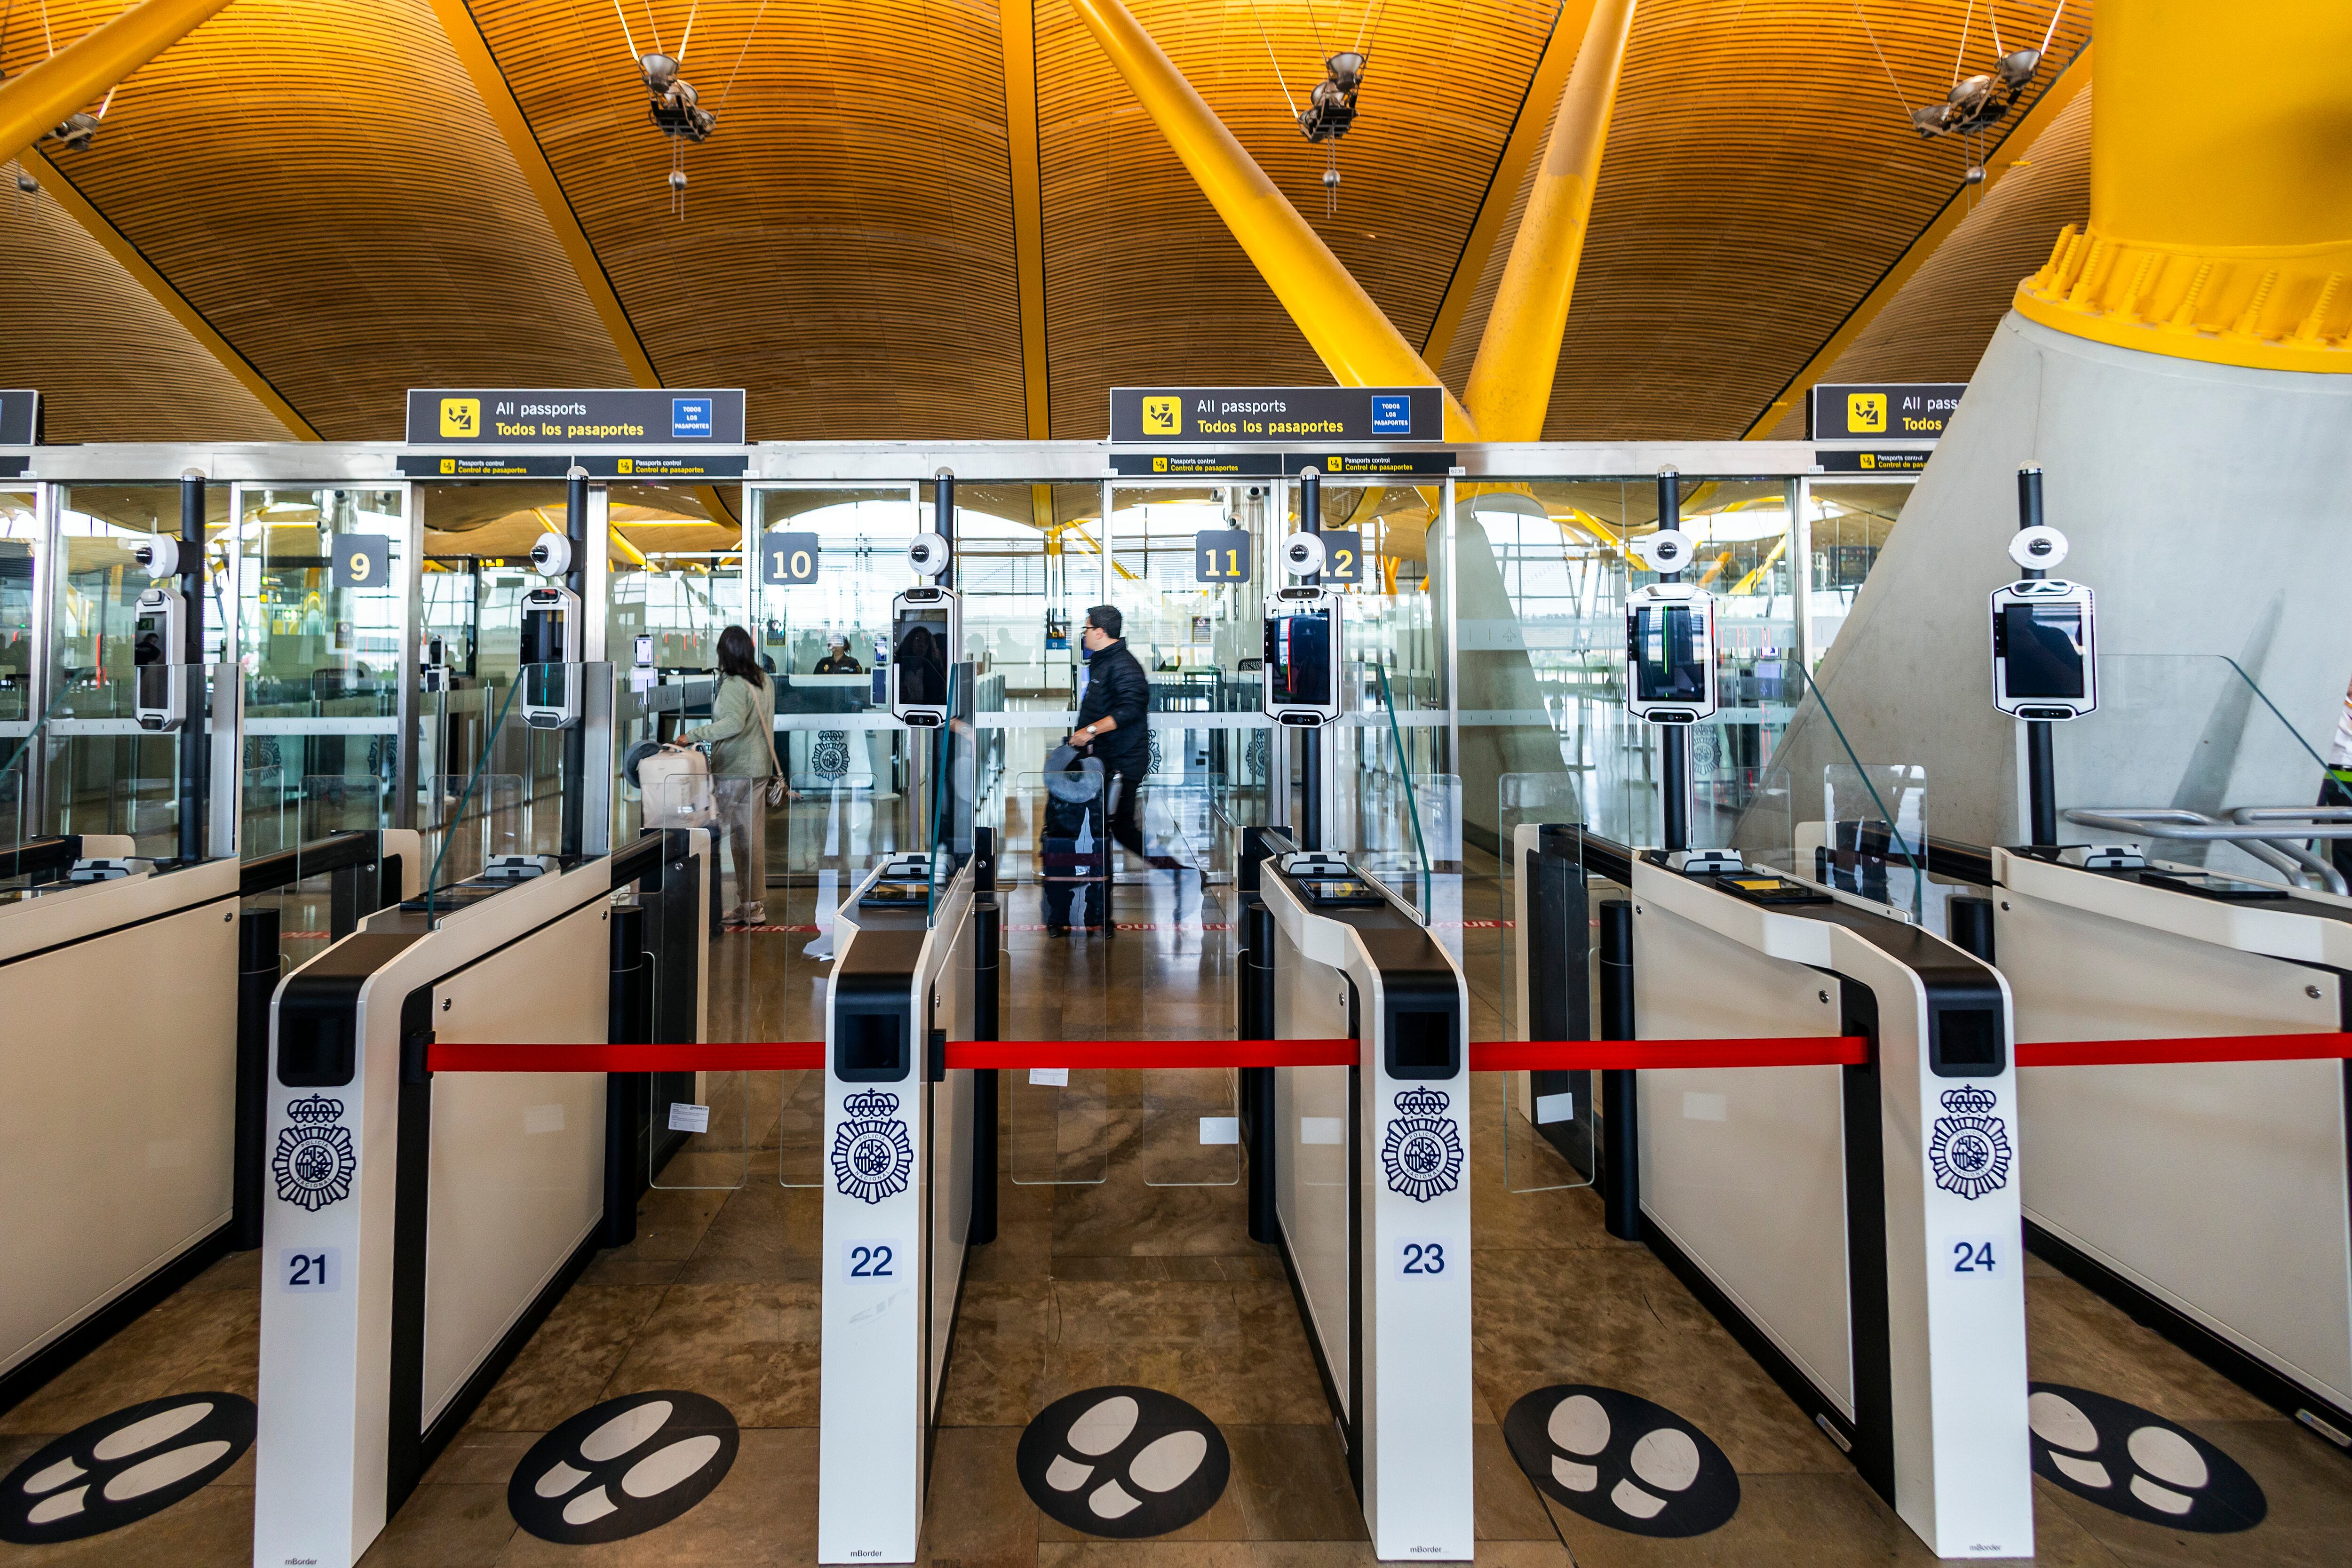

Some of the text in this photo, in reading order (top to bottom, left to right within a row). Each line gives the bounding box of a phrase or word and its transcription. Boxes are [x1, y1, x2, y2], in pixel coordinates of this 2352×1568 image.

[496, 402, 586, 417] All passports
[1198, 400, 1286, 415] All passports
[1903, 397, 1961, 412] All pass
[496, 422, 644, 438] Todos los pasaportes
[1198, 420, 1343, 435] Todos los pasaportes
[1903, 418, 1941, 430] Todos
[350, 553, 370, 581] 9
[773, 551, 811, 578] 10
[1206, 549, 1240, 576] 11
[855, 1170, 890, 1181] NACIONAL
[1406, 1168, 1439, 1179] NACIONAL
[296, 1177, 332, 1188] NACIONAL
[851, 1246, 892, 1277] 22
[1403, 1244, 1444, 1274] 23
[1955, 1242, 1995, 1272] 24
[290, 1255, 325, 1285] 21
